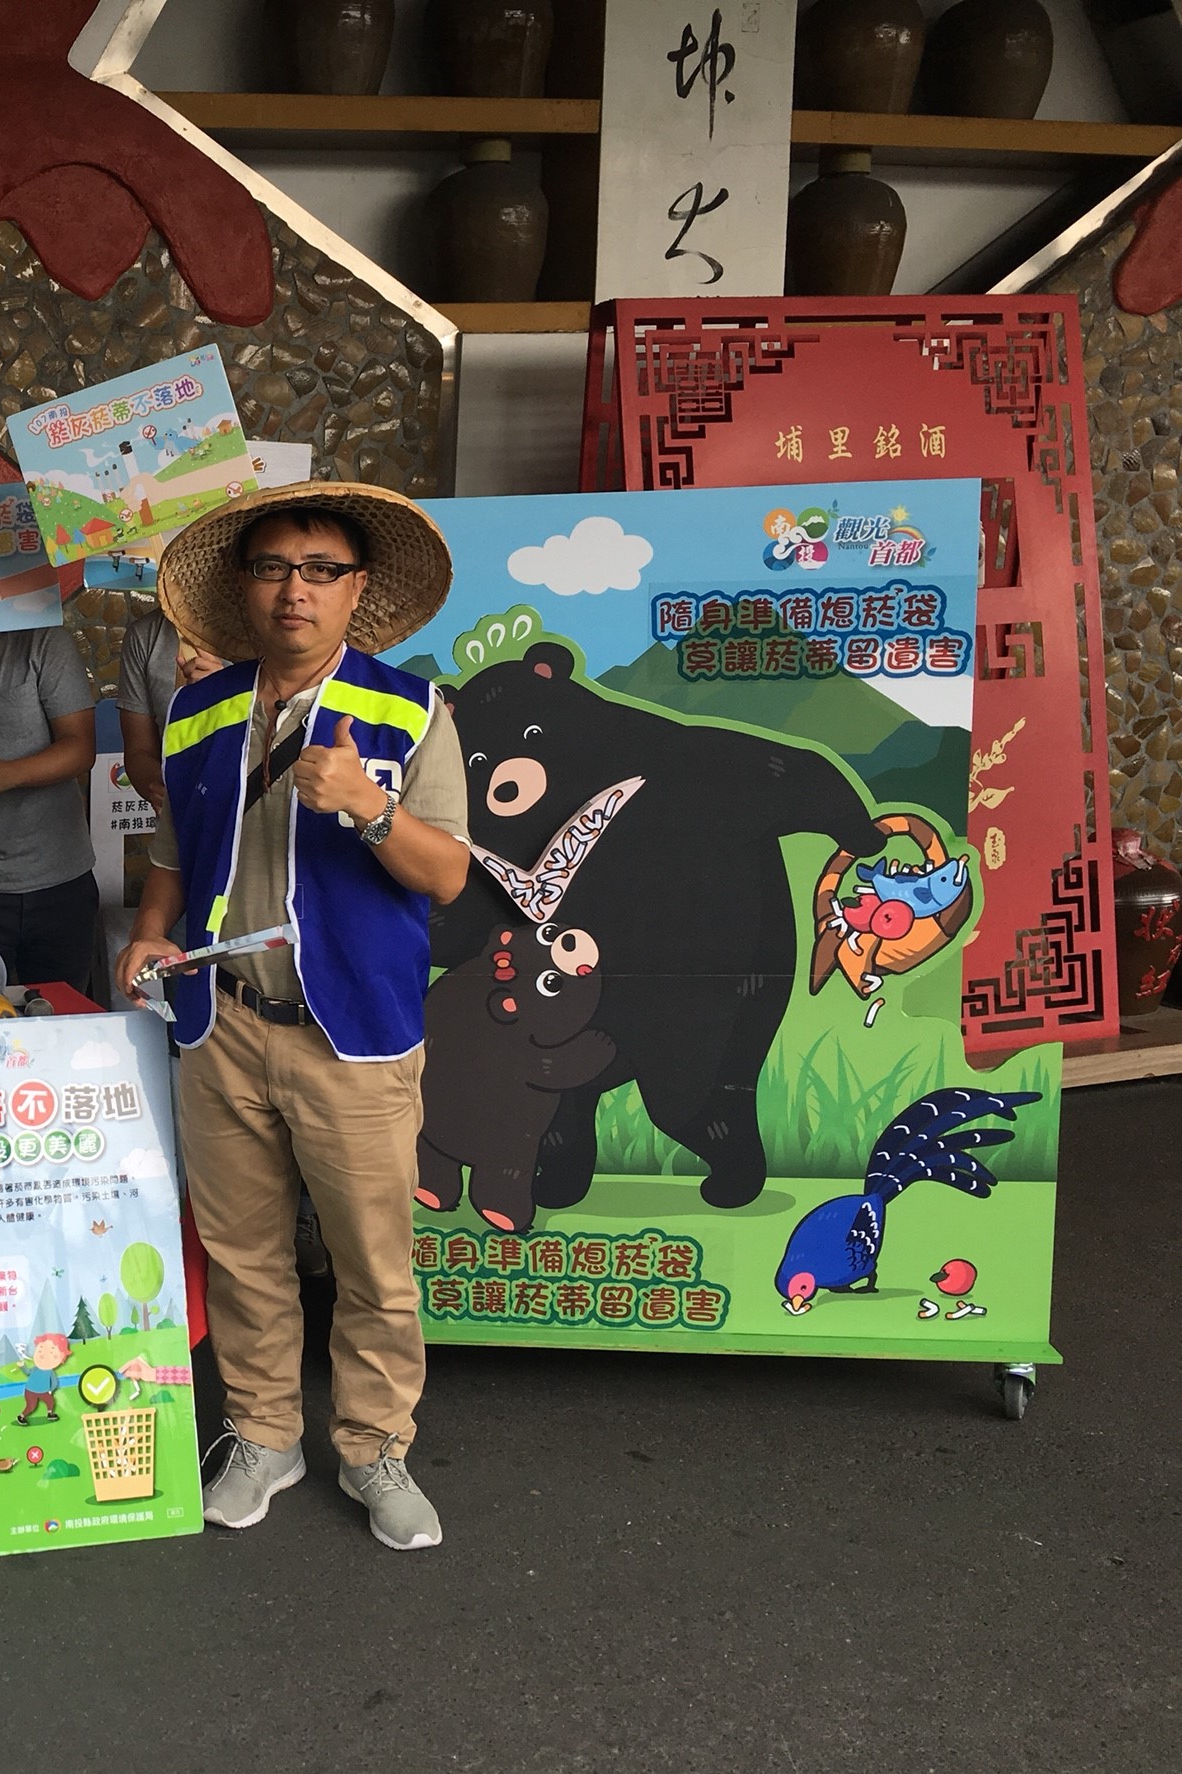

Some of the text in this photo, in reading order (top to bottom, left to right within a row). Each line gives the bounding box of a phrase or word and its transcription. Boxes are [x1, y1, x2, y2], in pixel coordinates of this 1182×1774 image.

[30, 405, 68, 432] 107南投
[47, 378, 197, 446] 菸灰菸蒂不落地
[774, 423, 947, 462] 埔里銘酒
[835, 516, 891, 542] 觀光
[838, 542, 869, 550] Nantou
[870, 539, 925, 565] 首都
[658, 586, 940, 634] 隨身準備熄菸袋
[684, 634, 964, 675] 莫讓菸蒂留遺害
[413, 1235, 694, 1279] 隨身準備熄菸袋
[430, 1278, 721, 1323] 莫讓菸蒂留遺害
